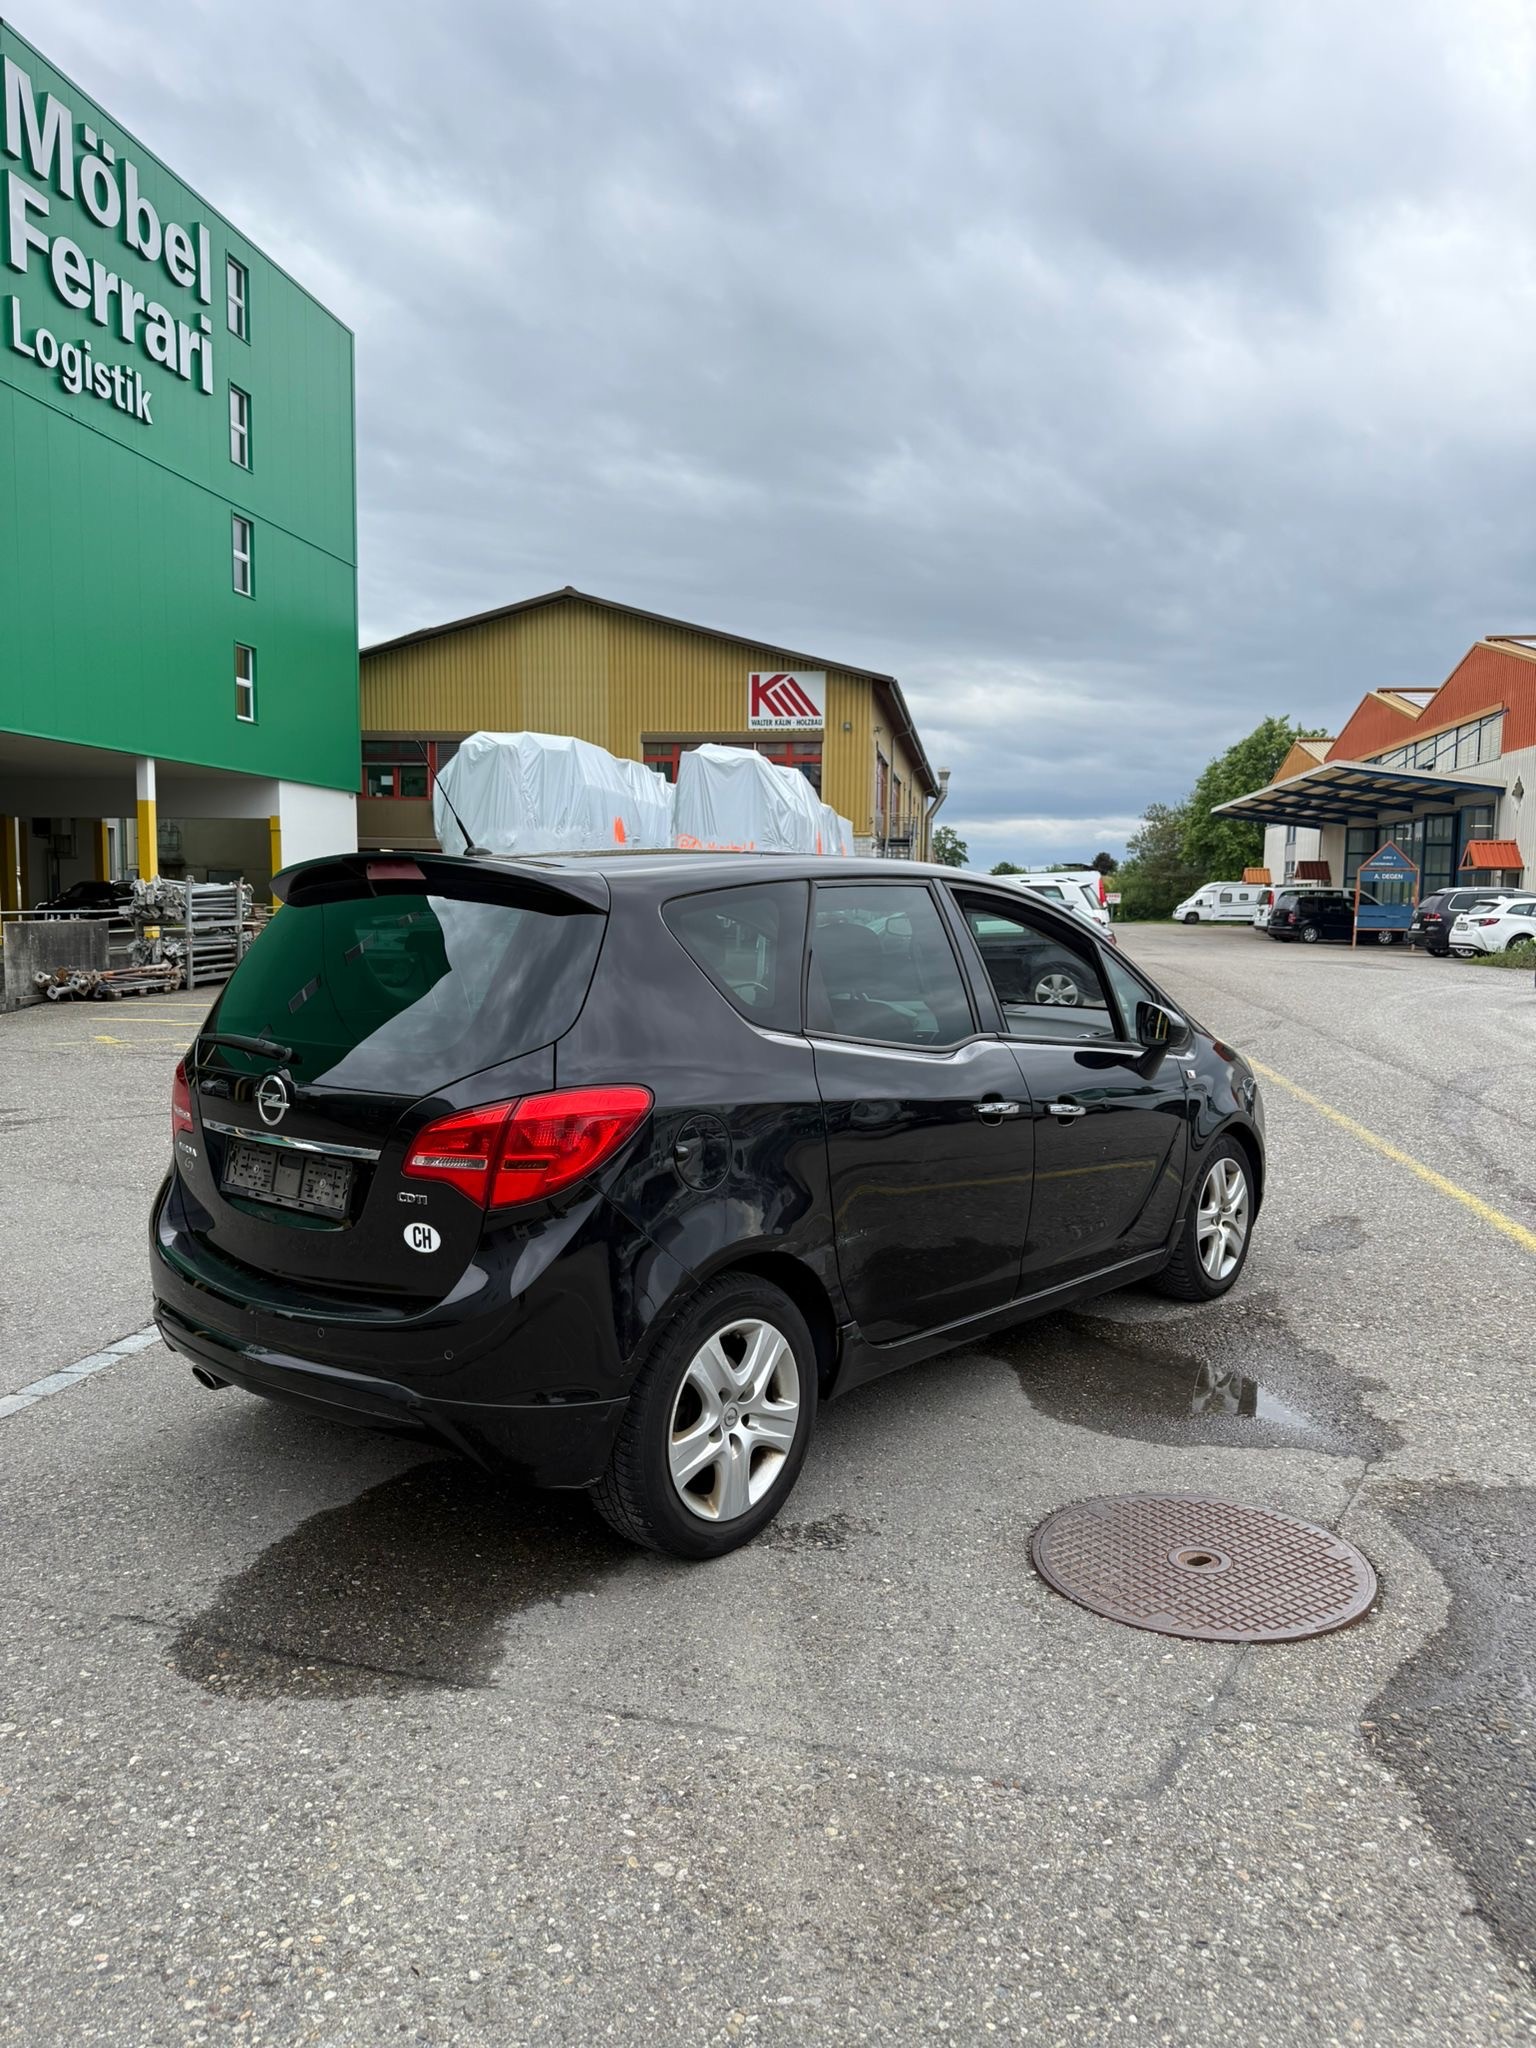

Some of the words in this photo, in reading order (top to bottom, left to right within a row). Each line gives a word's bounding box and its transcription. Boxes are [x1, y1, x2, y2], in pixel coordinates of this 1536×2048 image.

[3, 54, 211, 305] Möbel
[4, 168, 213, 395] Ferrari
[10, 295, 153, 425] Logistik
[796, 718, 823, 726] HOLZBAU
[413, 1225, 432, 1250] CH
